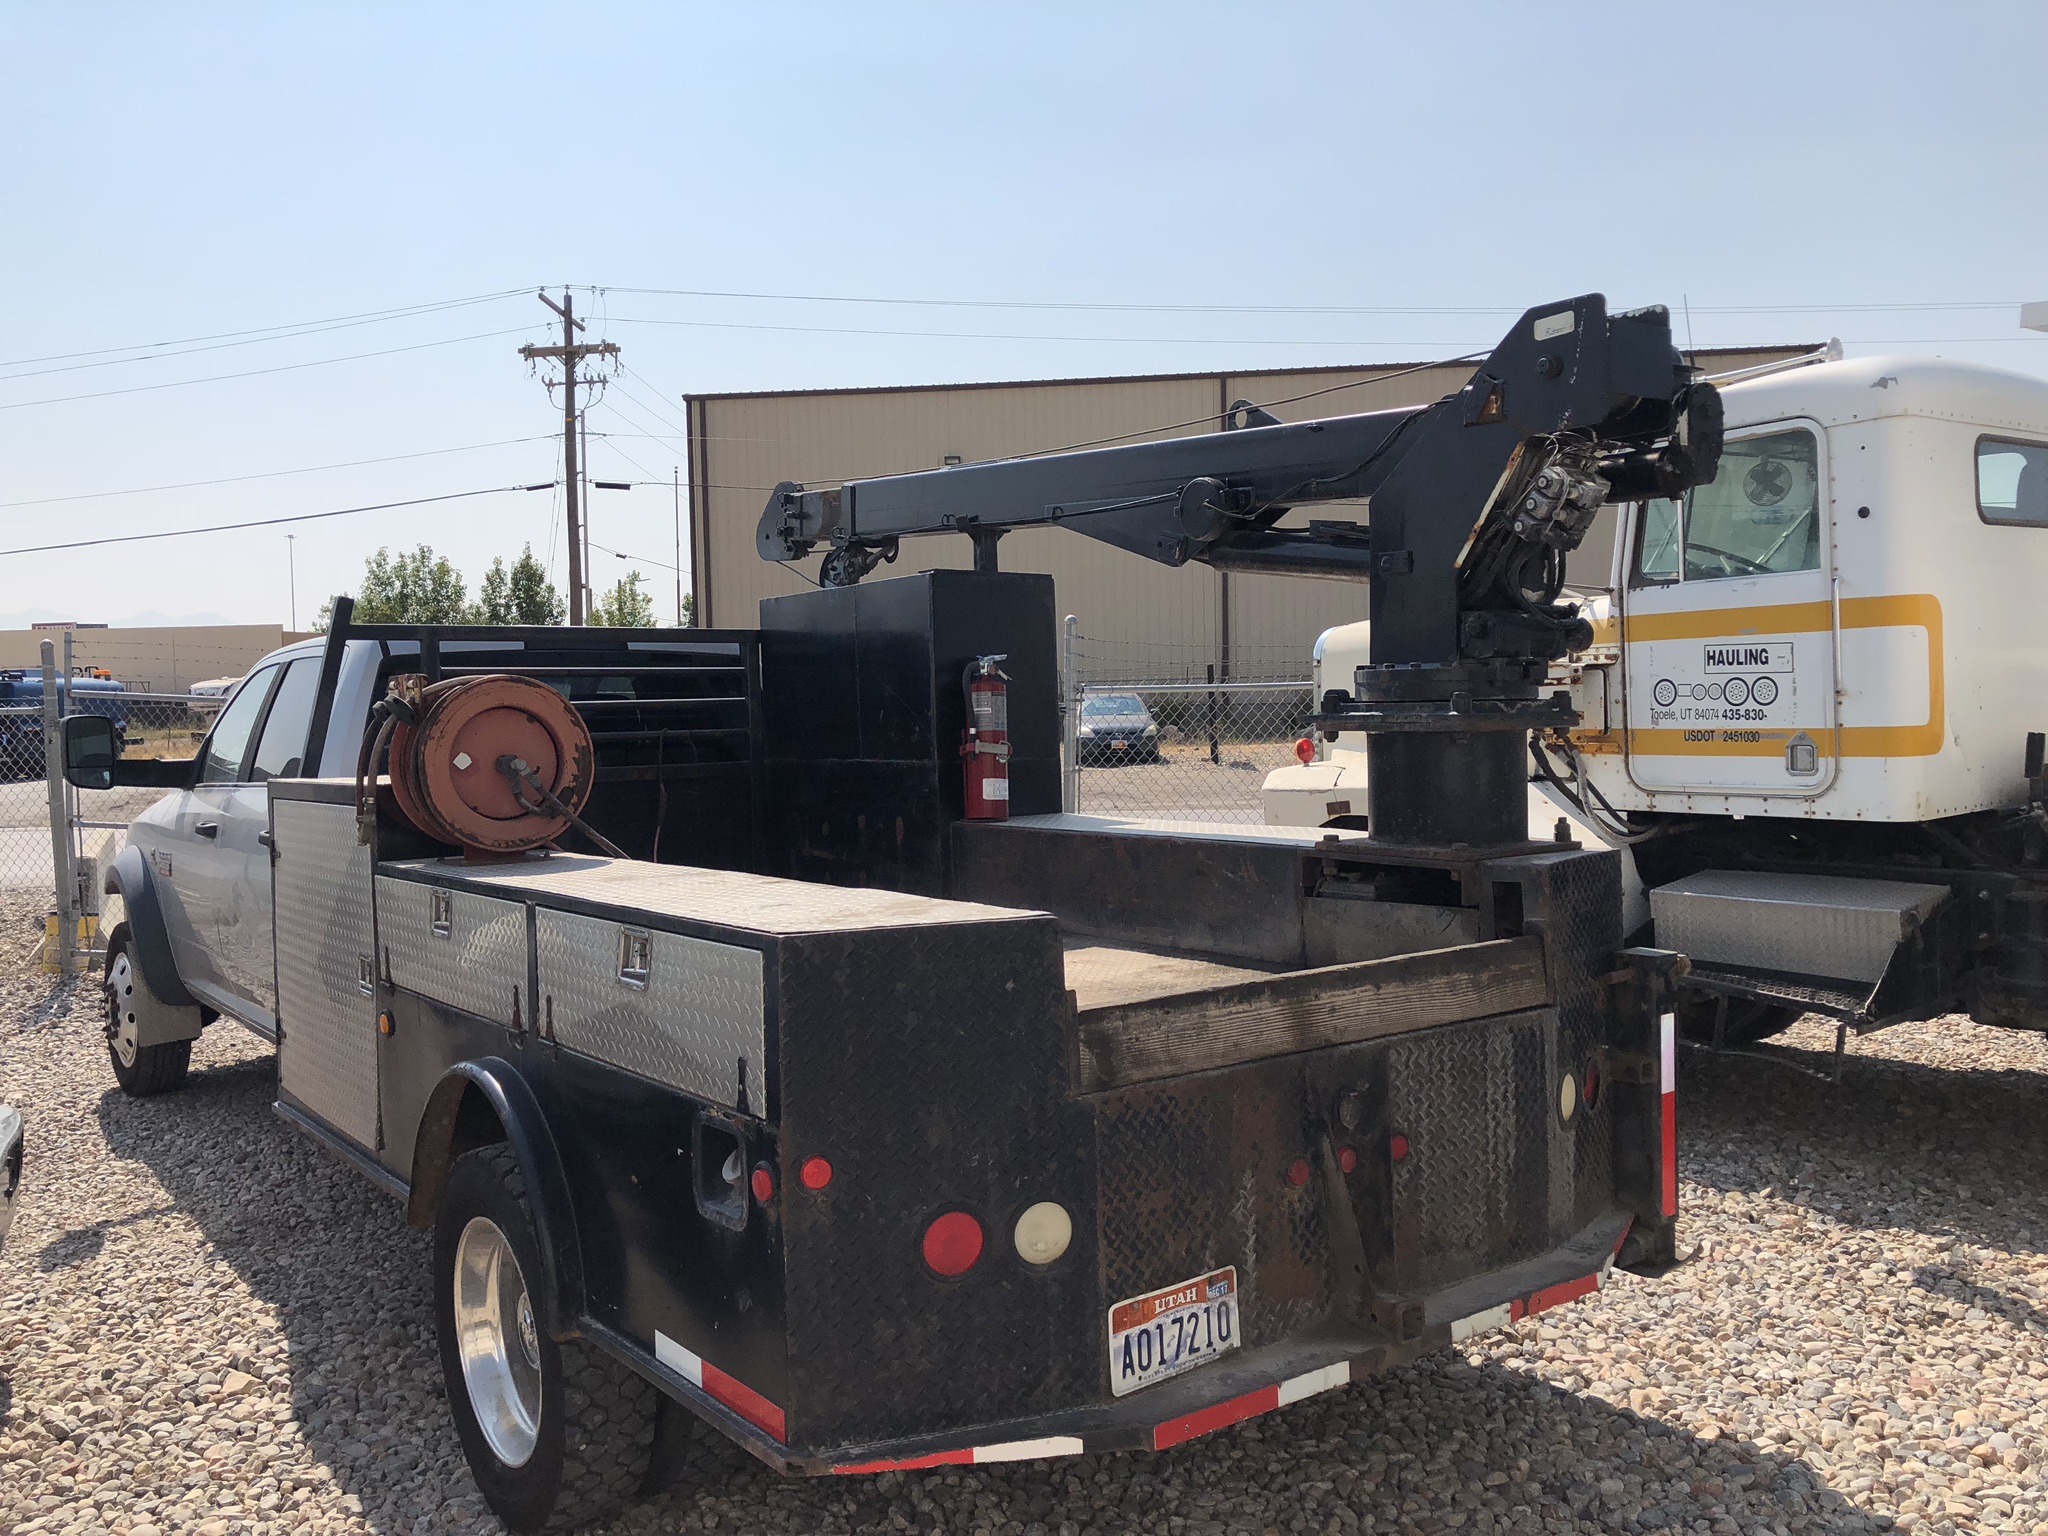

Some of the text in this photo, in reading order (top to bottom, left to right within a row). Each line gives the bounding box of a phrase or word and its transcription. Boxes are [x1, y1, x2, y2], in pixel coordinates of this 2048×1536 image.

[1706, 648, 1769, 666] HAULING
[1680, 708, 1692, 720] UT
[1694, 709, 1719, 720] 84074
[1684, 731, 1760, 742] USDOT 2451030
[1154, 1287, 1197, 1315] UTAH
[1122, 1300, 1232, 1380] A017210
